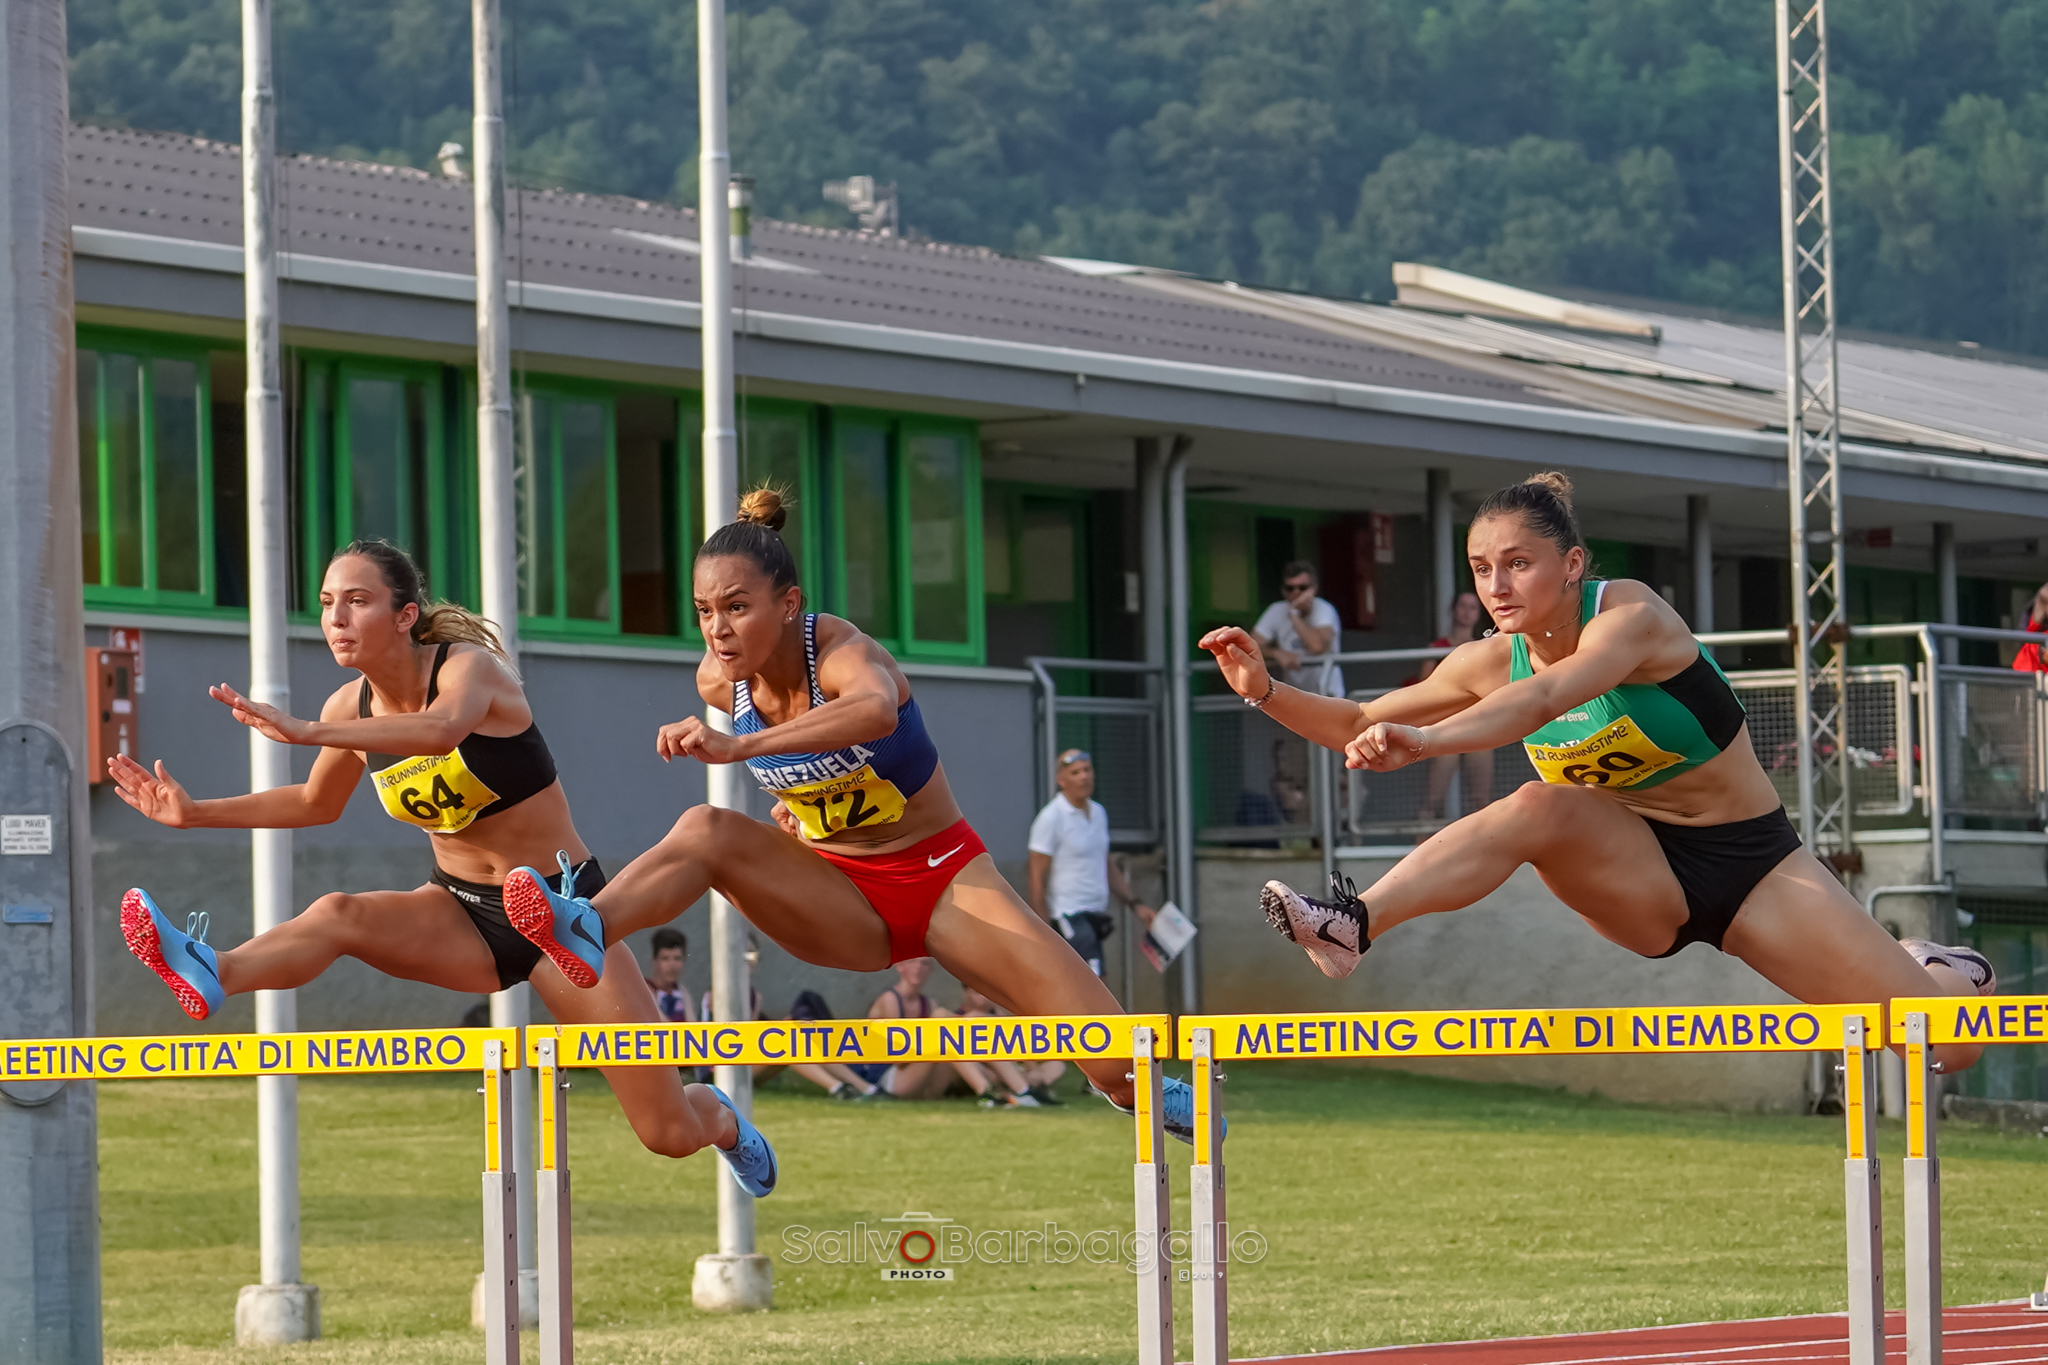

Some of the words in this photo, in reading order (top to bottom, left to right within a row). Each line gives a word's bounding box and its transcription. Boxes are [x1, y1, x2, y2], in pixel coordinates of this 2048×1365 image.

[1547, 725, 1629, 761] RUNNINGTIME
[1562, 751, 1646, 785] 60
[400, 773, 465, 820] 64
[1235, 1018, 1418, 1054] MEETING
[1434, 1016, 1554, 1050] CITTA'
[1575, 1015, 1613, 1047] DI
[1633, 1012, 1820, 1046] NEMBRO
[1953, 1004, 2048, 1037] MEE
[0, 1043, 126, 1075] EETING
[140, 1041, 242, 1071] CITTA'
[259, 1040, 291, 1069] DI
[308, 1035, 465, 1068] NEMBRO
[577, 1028, 743, 1060] MEETING
[758, 1026, 868, 1058] CITTA'
[887, 1026, 922, 1056] DI
[940, 1022, 1111, 1055] NEMBRO
